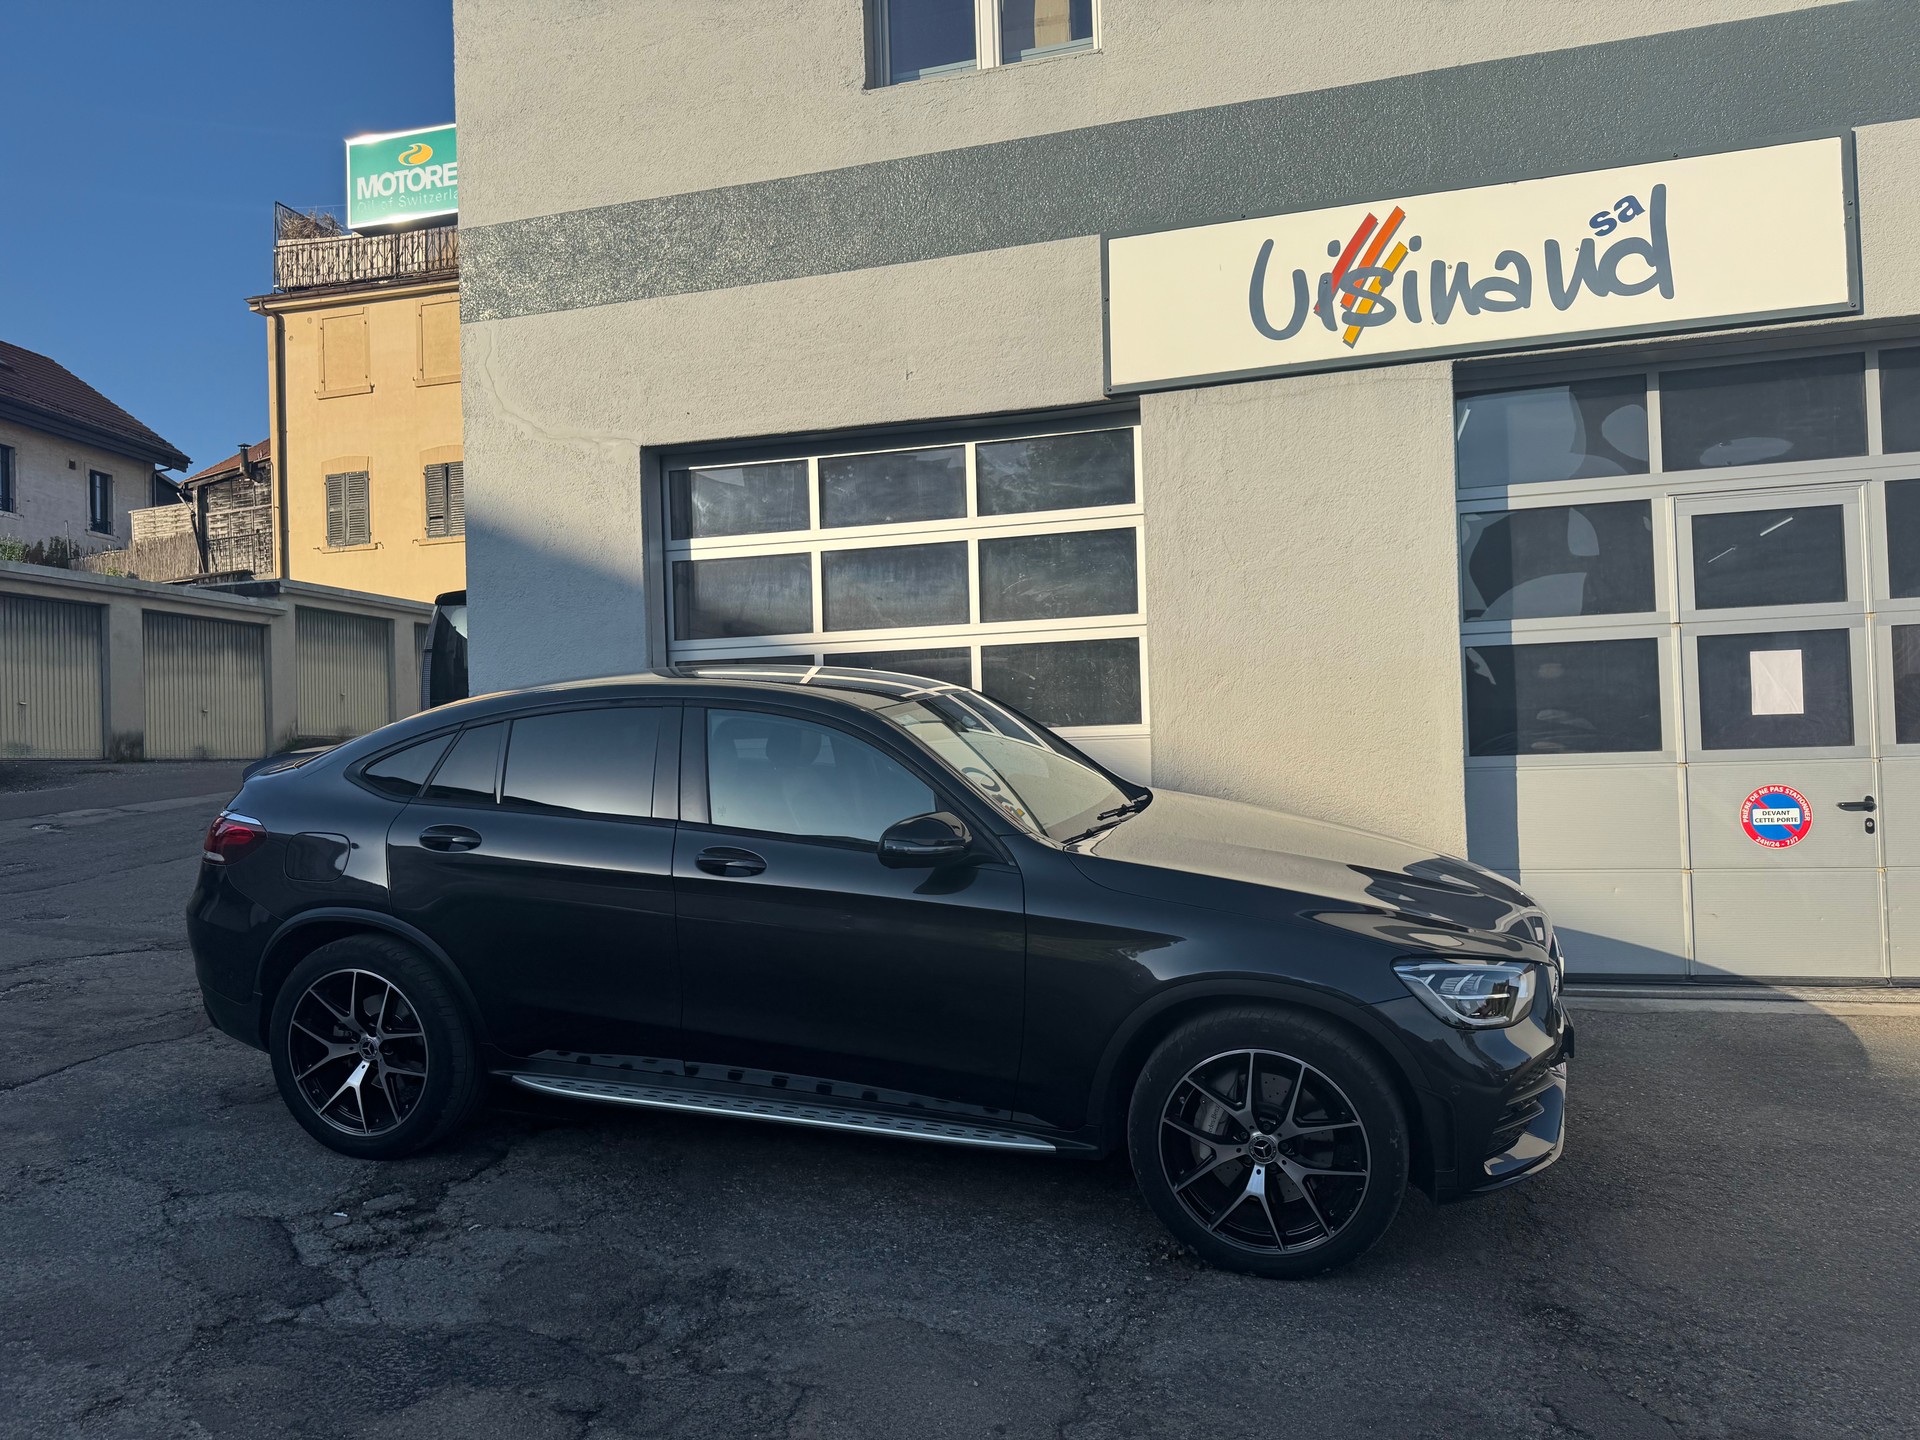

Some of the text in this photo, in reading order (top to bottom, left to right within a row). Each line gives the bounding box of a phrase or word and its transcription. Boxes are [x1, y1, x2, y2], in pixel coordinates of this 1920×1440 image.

[382, 196, 393, 210] of
[1588, 194, 1646, 237] sa
[1742, 801, 1752, 822] PRIÈRE
[1749, 793, 1759, 802] DE
[1759, 787, 1769, 795] NE
[1785, 788, 1810, 821] STATIONNER
[1756, 836, 1780, 847] 24H/24
